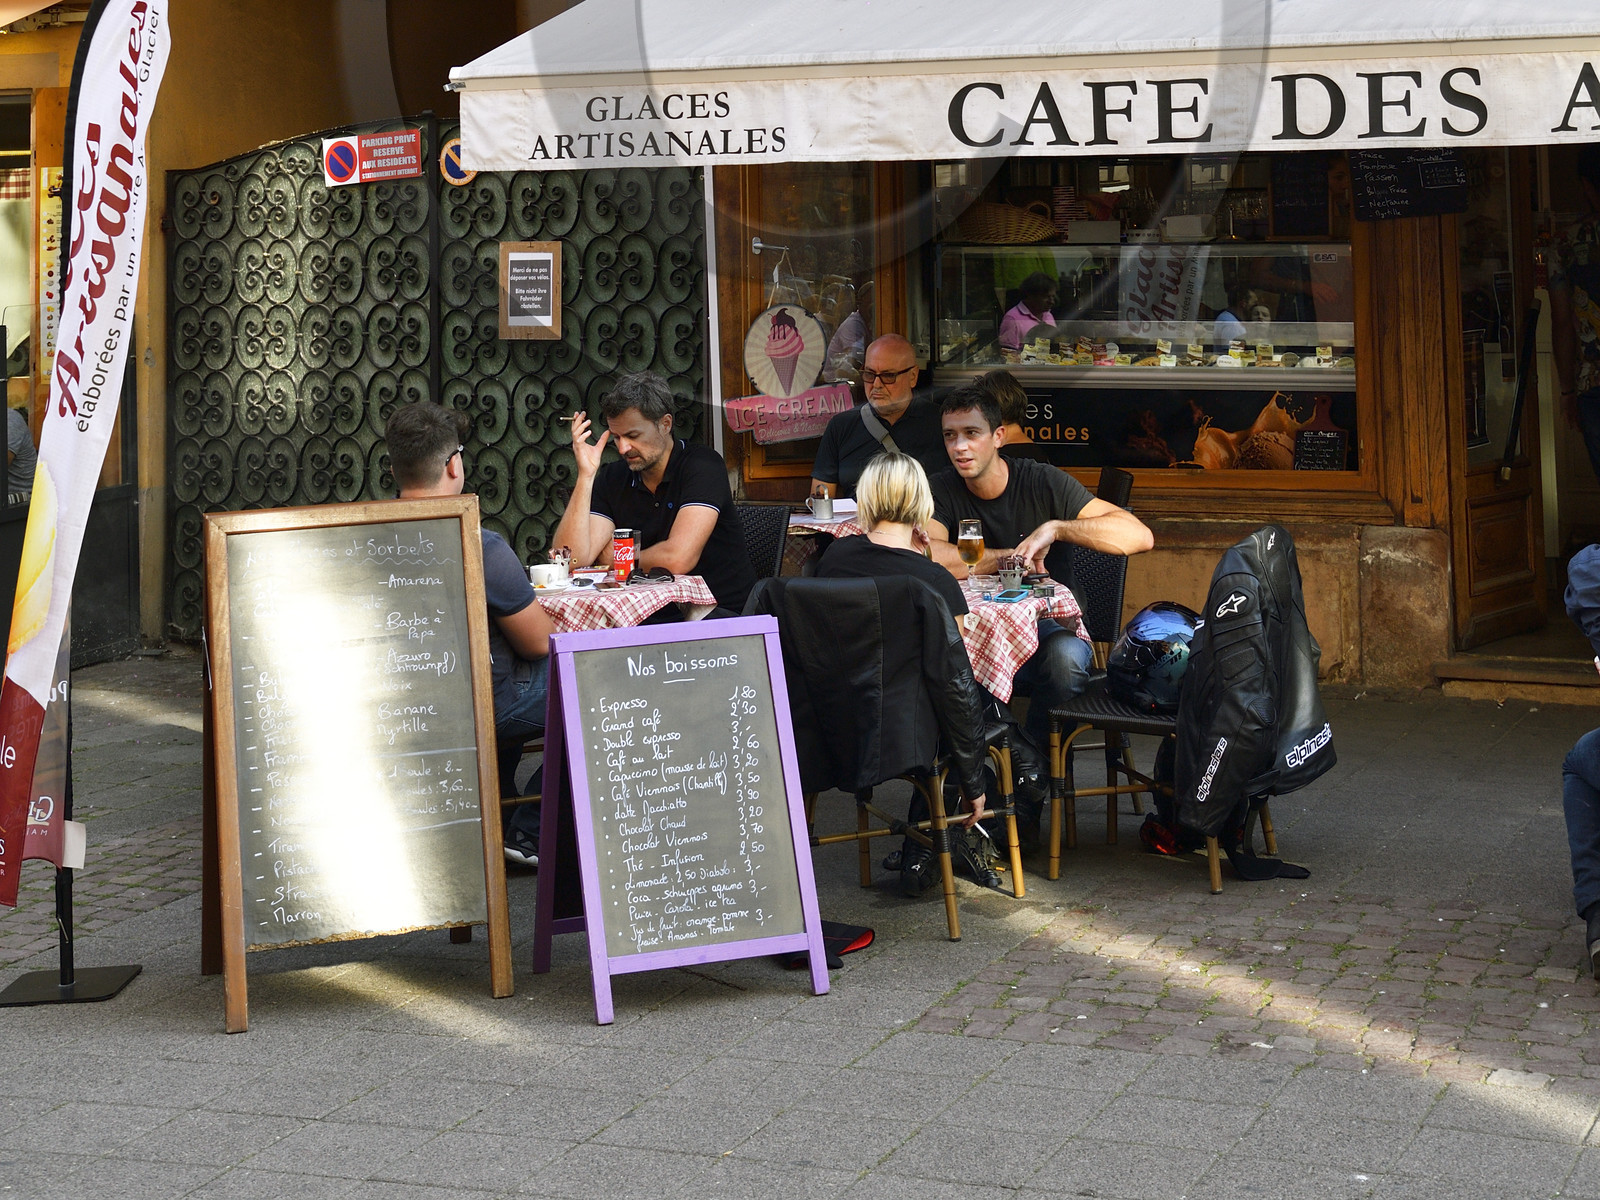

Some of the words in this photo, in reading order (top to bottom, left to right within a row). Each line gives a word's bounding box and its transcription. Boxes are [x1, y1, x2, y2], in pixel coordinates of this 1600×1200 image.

[585, 91, 731, 122] GLACES
[947, 78, 1213, 148] CAFE
[1271, 67, 1488, 140] DES
[361, 136, 393, 148] PARKING
[395, 133, 416, 145] PRIVE
[373, 146, 404, 157] RESERVE
[528, 127, 786, 161] ARTISANALES
[362, 160, 377, 170] AUX
[377, 155, 417, 168] RESIDENTS
[362, 170, 396, 180] STATIONNEMENT
[397, 168, 418, 176] INTERDIT
[76, 327, 120, 433] élaborées
[113, 284, 131, 321] par
[125, 252, 137, 277] un
[139, 5, 161, 83] Glacier
[1126, 245, 1156, 334] Glac
[734, 393, 847, 428] ICE-CREAM
[345, 540, 364, 557] et
[367, 531, 435, 556] Sorbets
[388, 574, 444, 589] Amarena
[386, 612, 430, 630] Barbe
[434, 608, 446, 624] à
[408, 627, 436, 645] Papa
[626, 652, 656, 678] Nos
[378, 702, 438, 720] Banane
[600, 697, 649, 719] Expresso
[601, 717, 635, 733] Grand
[642, 708, 661, 732] café
[603, 730, 635, 751] Double
[642, 732, 681, 749] expresso
[606, 750, 626, 772] Café
[652, 744, 674, 761] lait
[661, 762, 694, 782] (mousse
[696, 757, 706, 770] de
[708, 750, 728, 769] lait)
[1196, 737, 1228, 802] alpinestars
[611, 783, 631, 808] Café
[619, 816, 655, 836] Chocolat
[660, 815, 687, 831] Chaud
[622, 832, 660, 853] Chocolat
[623, 854, 644, 873] Thé
[661, 849, 705, 872] Infusion
[627, 891, 651, 904] Coca
[705, 900, 718, 909] ice
[721, 894, 737, 906] tea
[273, 906, 321, 925] Marron
[630, 924, 645, 941] Jus
[647, 920, 656, 933] de
[667, 929, 698, 942] Ananas
